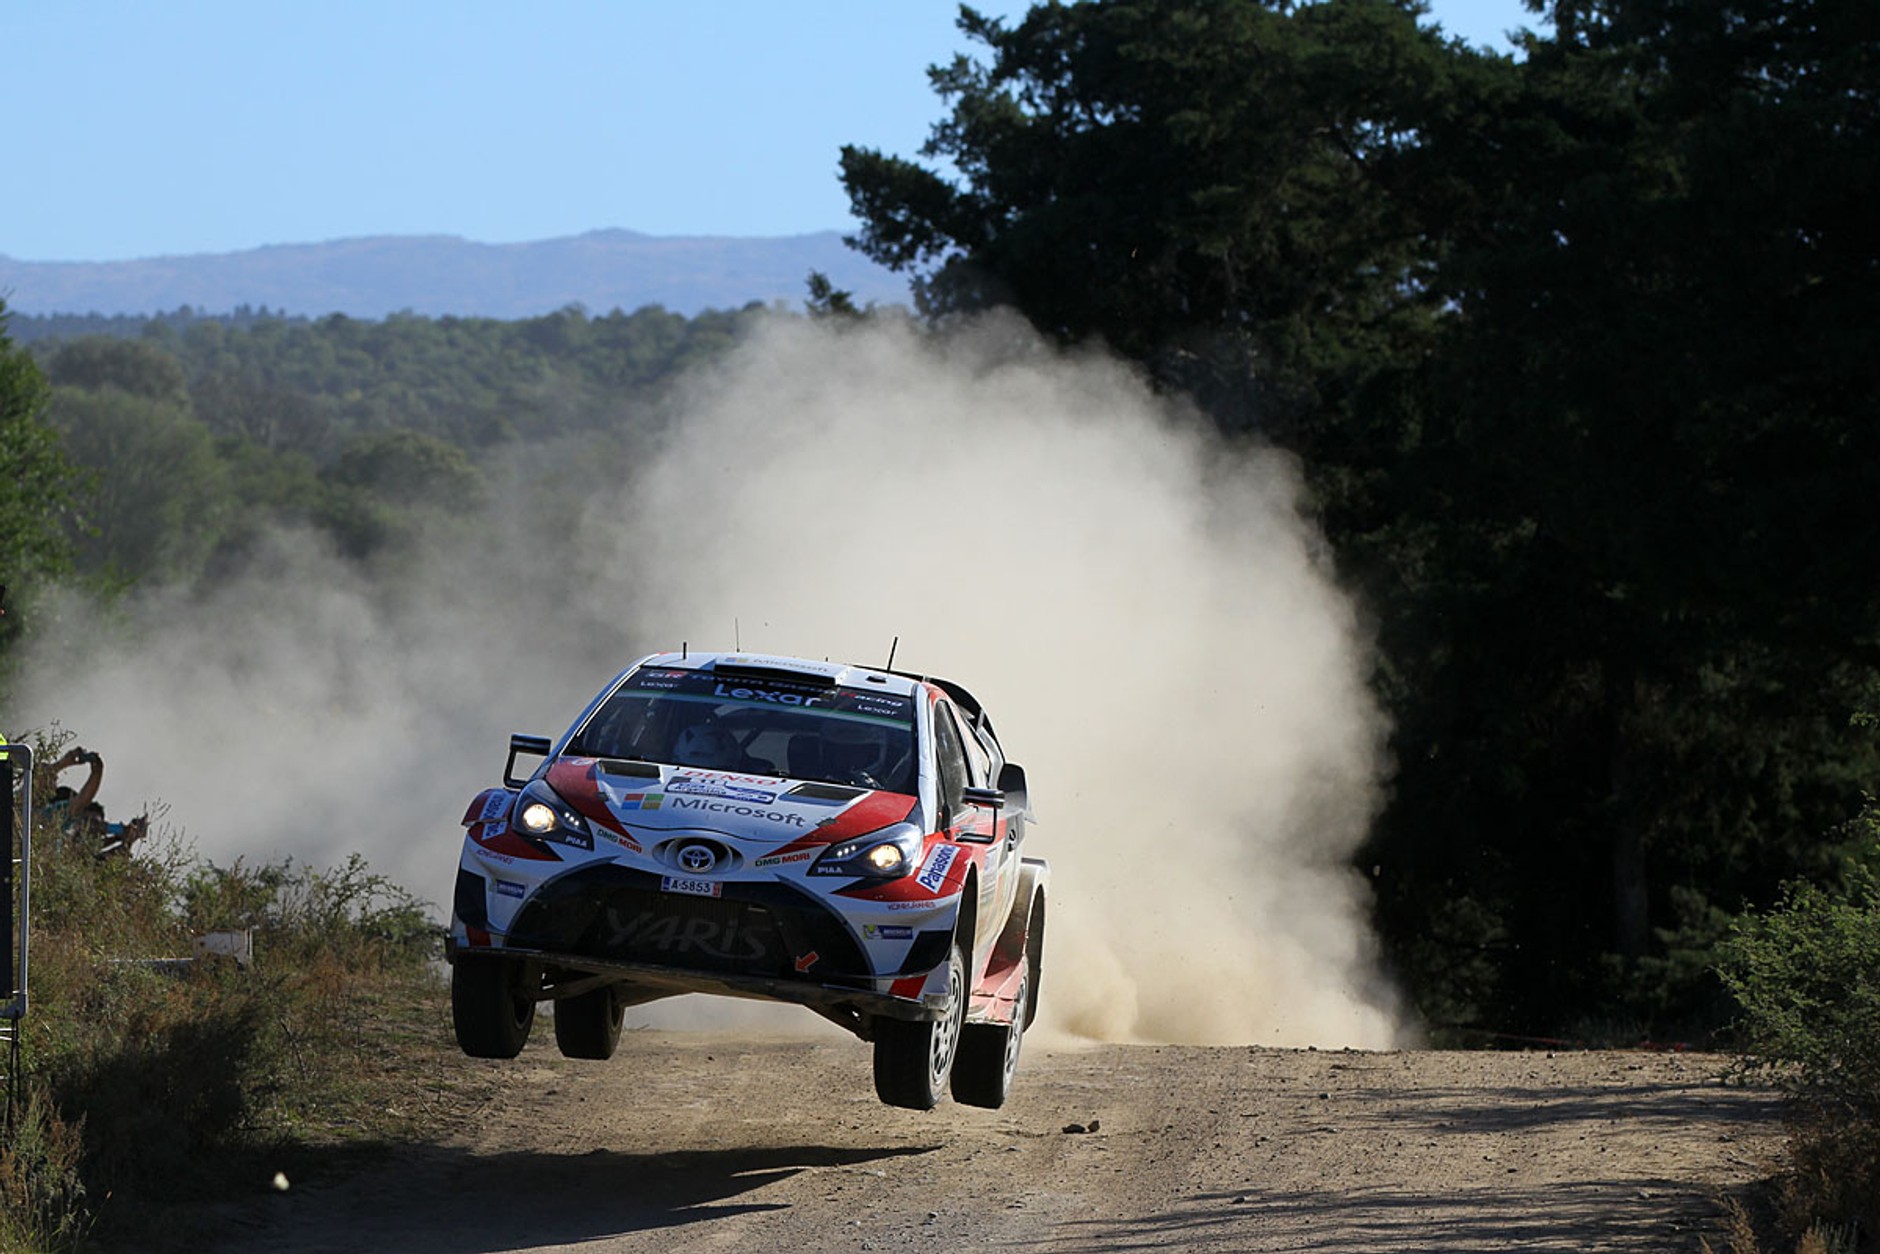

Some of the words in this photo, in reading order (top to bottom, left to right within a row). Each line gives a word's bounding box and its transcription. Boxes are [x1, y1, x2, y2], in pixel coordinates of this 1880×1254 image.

[752, 658, 829, 673] Microsoft
[714, 683, 822, 707] Lexar
[857, 703, 899, 716] Lexar
[684, 770, 778, 786] DENSO
[671, 797, 807, 828] Microsoft
[565, 834, 588, 849] PIAA
[597, 829, 619, 844] DMG
[618, 838, 644, 855] MORI
[755, 857, 781, 868] DMG
[781, 852, 810, 864] MORI
[817, 866, 843, 874] PIAA
